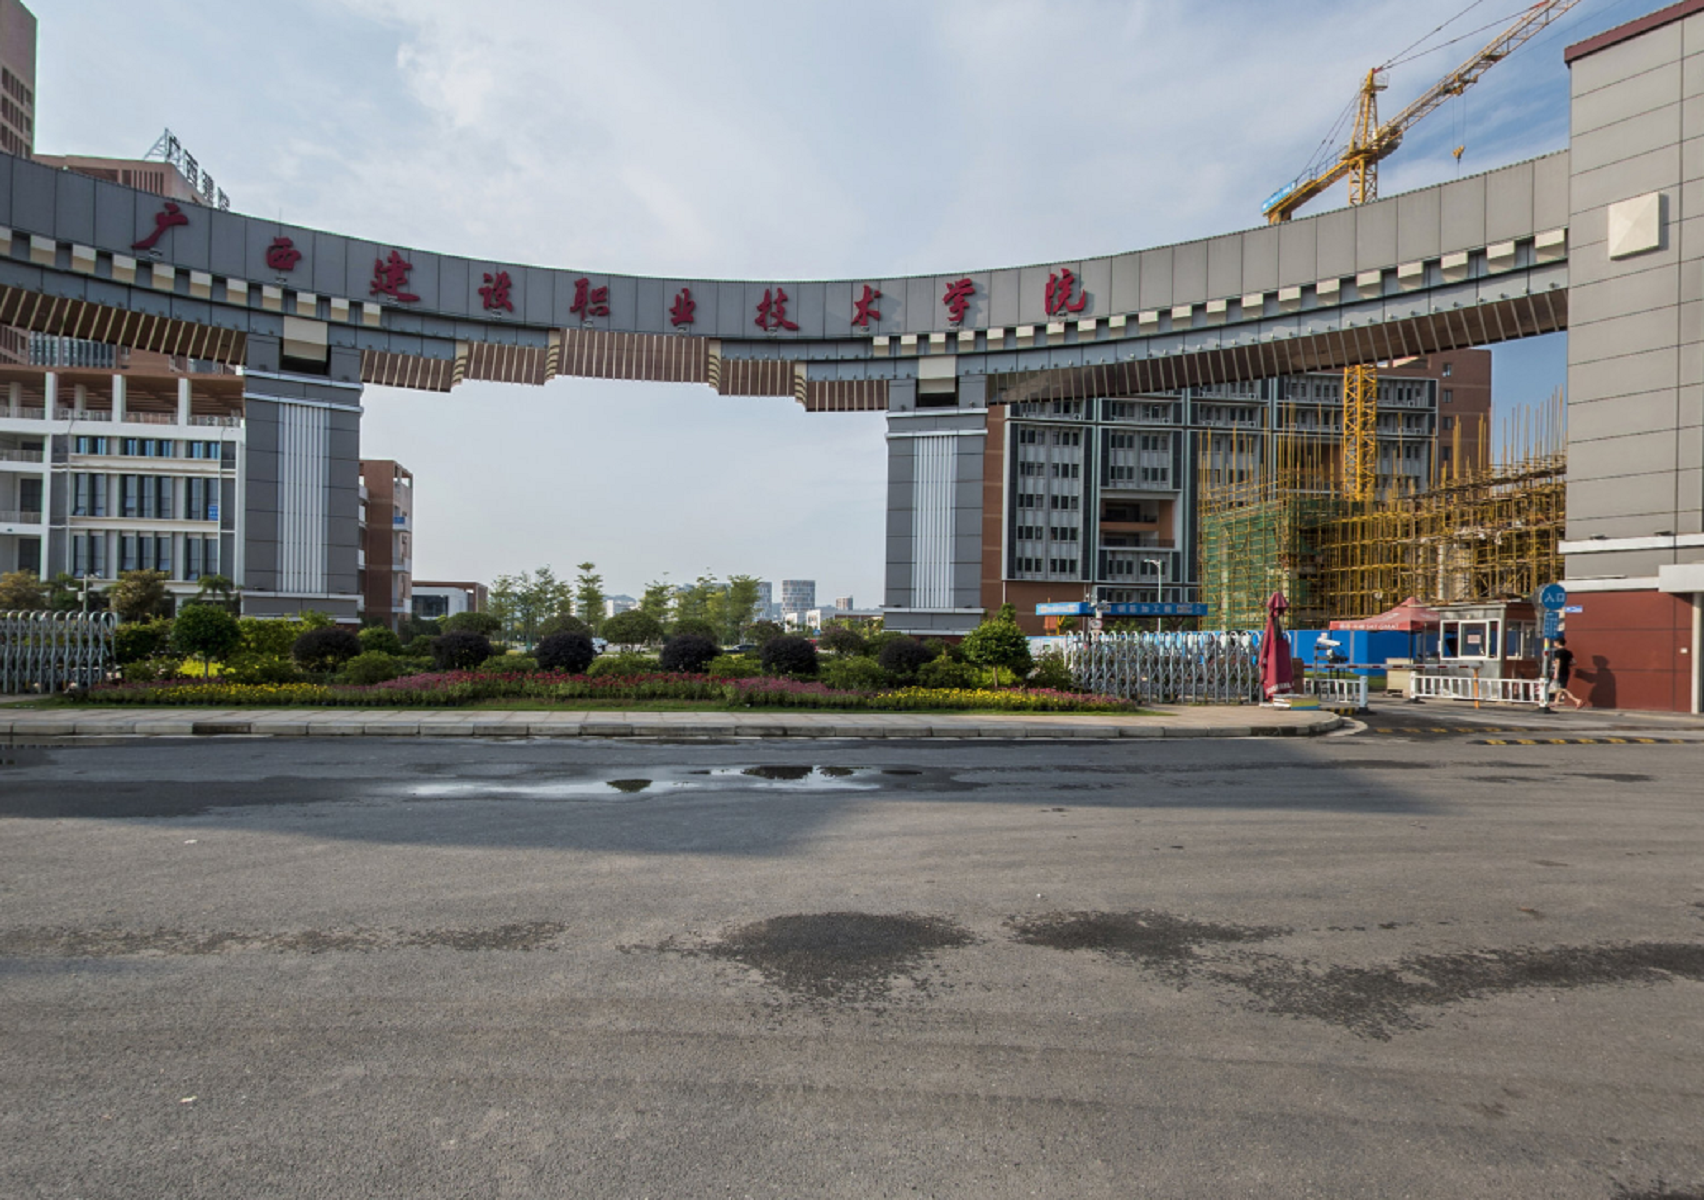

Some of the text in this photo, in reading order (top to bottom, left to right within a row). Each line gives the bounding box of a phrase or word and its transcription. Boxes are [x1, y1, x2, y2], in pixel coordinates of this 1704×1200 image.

[131, 202, 1086, 329] 广西建设职业技术学院
[1544, 592, 1565, 603] 入口
